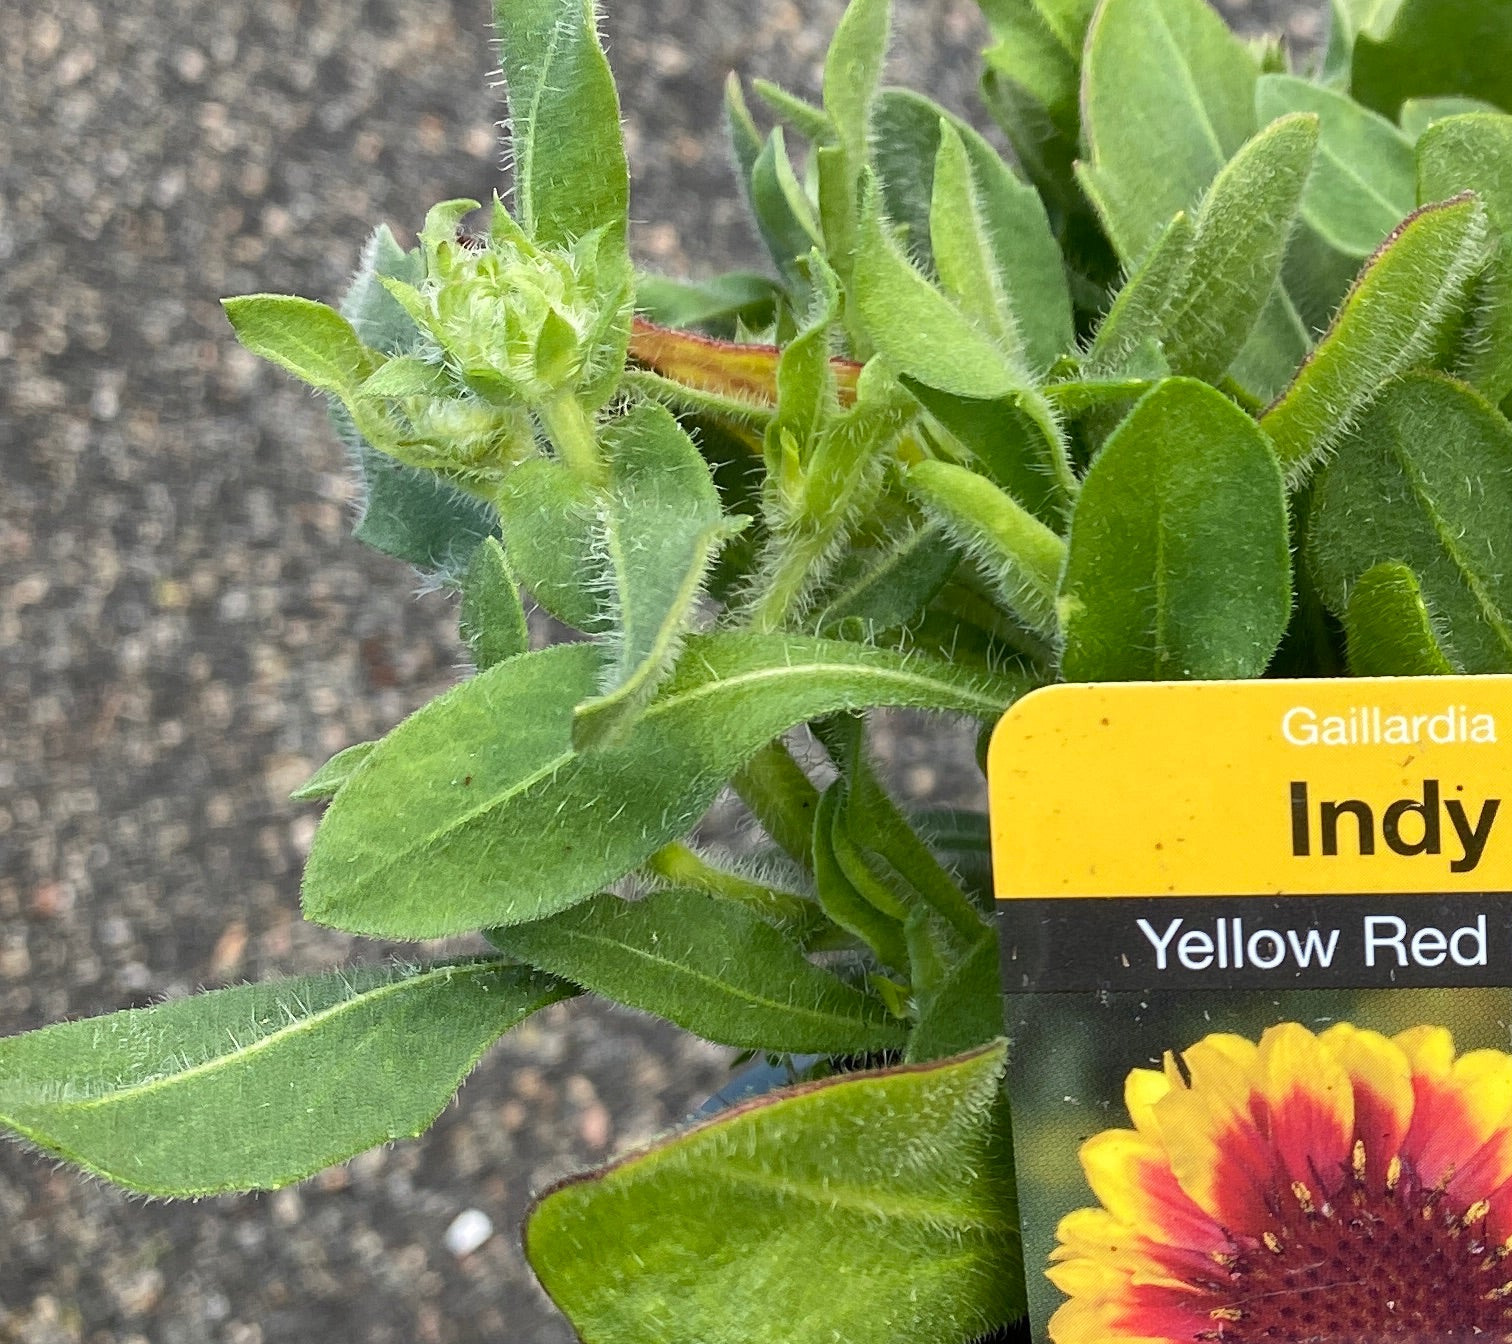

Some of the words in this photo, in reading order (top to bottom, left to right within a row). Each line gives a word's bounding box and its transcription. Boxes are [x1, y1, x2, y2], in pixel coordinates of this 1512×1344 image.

[1281, 704, 1497, 746] Gaillardia
[1290, 779, 1501, 873] Indy
[1136, 917, 1339, 969] Yellow
[1364, 914, 1487, 967] Red
